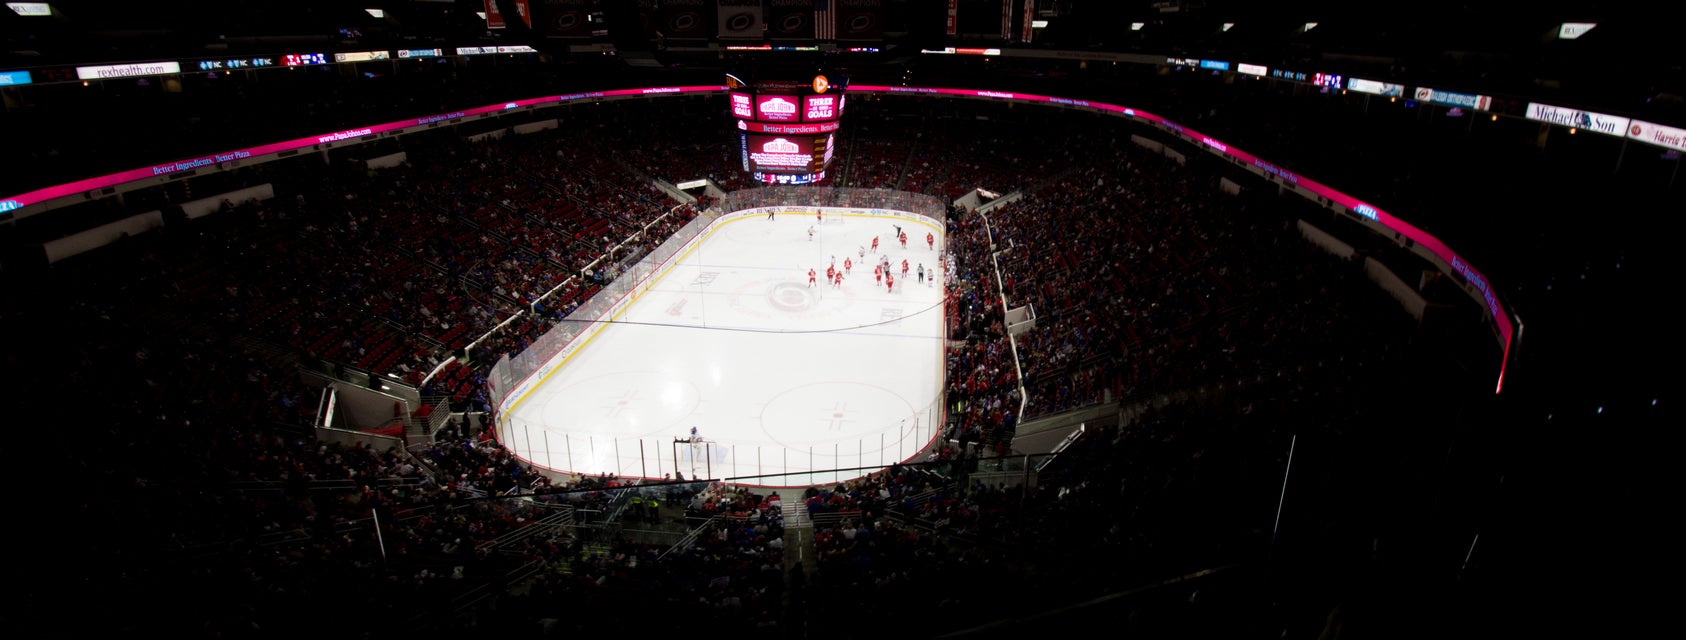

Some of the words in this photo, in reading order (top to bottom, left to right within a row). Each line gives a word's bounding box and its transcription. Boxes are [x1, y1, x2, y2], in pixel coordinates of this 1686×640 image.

[97, 66, 164, 77] rexhealth.com
[809, 98, 833, 106] THREE
[808, 110, 832, 118] GOALS
[1536, 106, 1574, 124] Michael
[1595, 116, 1615, 132] Son
[764, 124, 782, 133] Better
[1654, 130, 1680, 146] Harris
[153, 164, 175, 175] Better
[215, 154, 234, 162] Better
